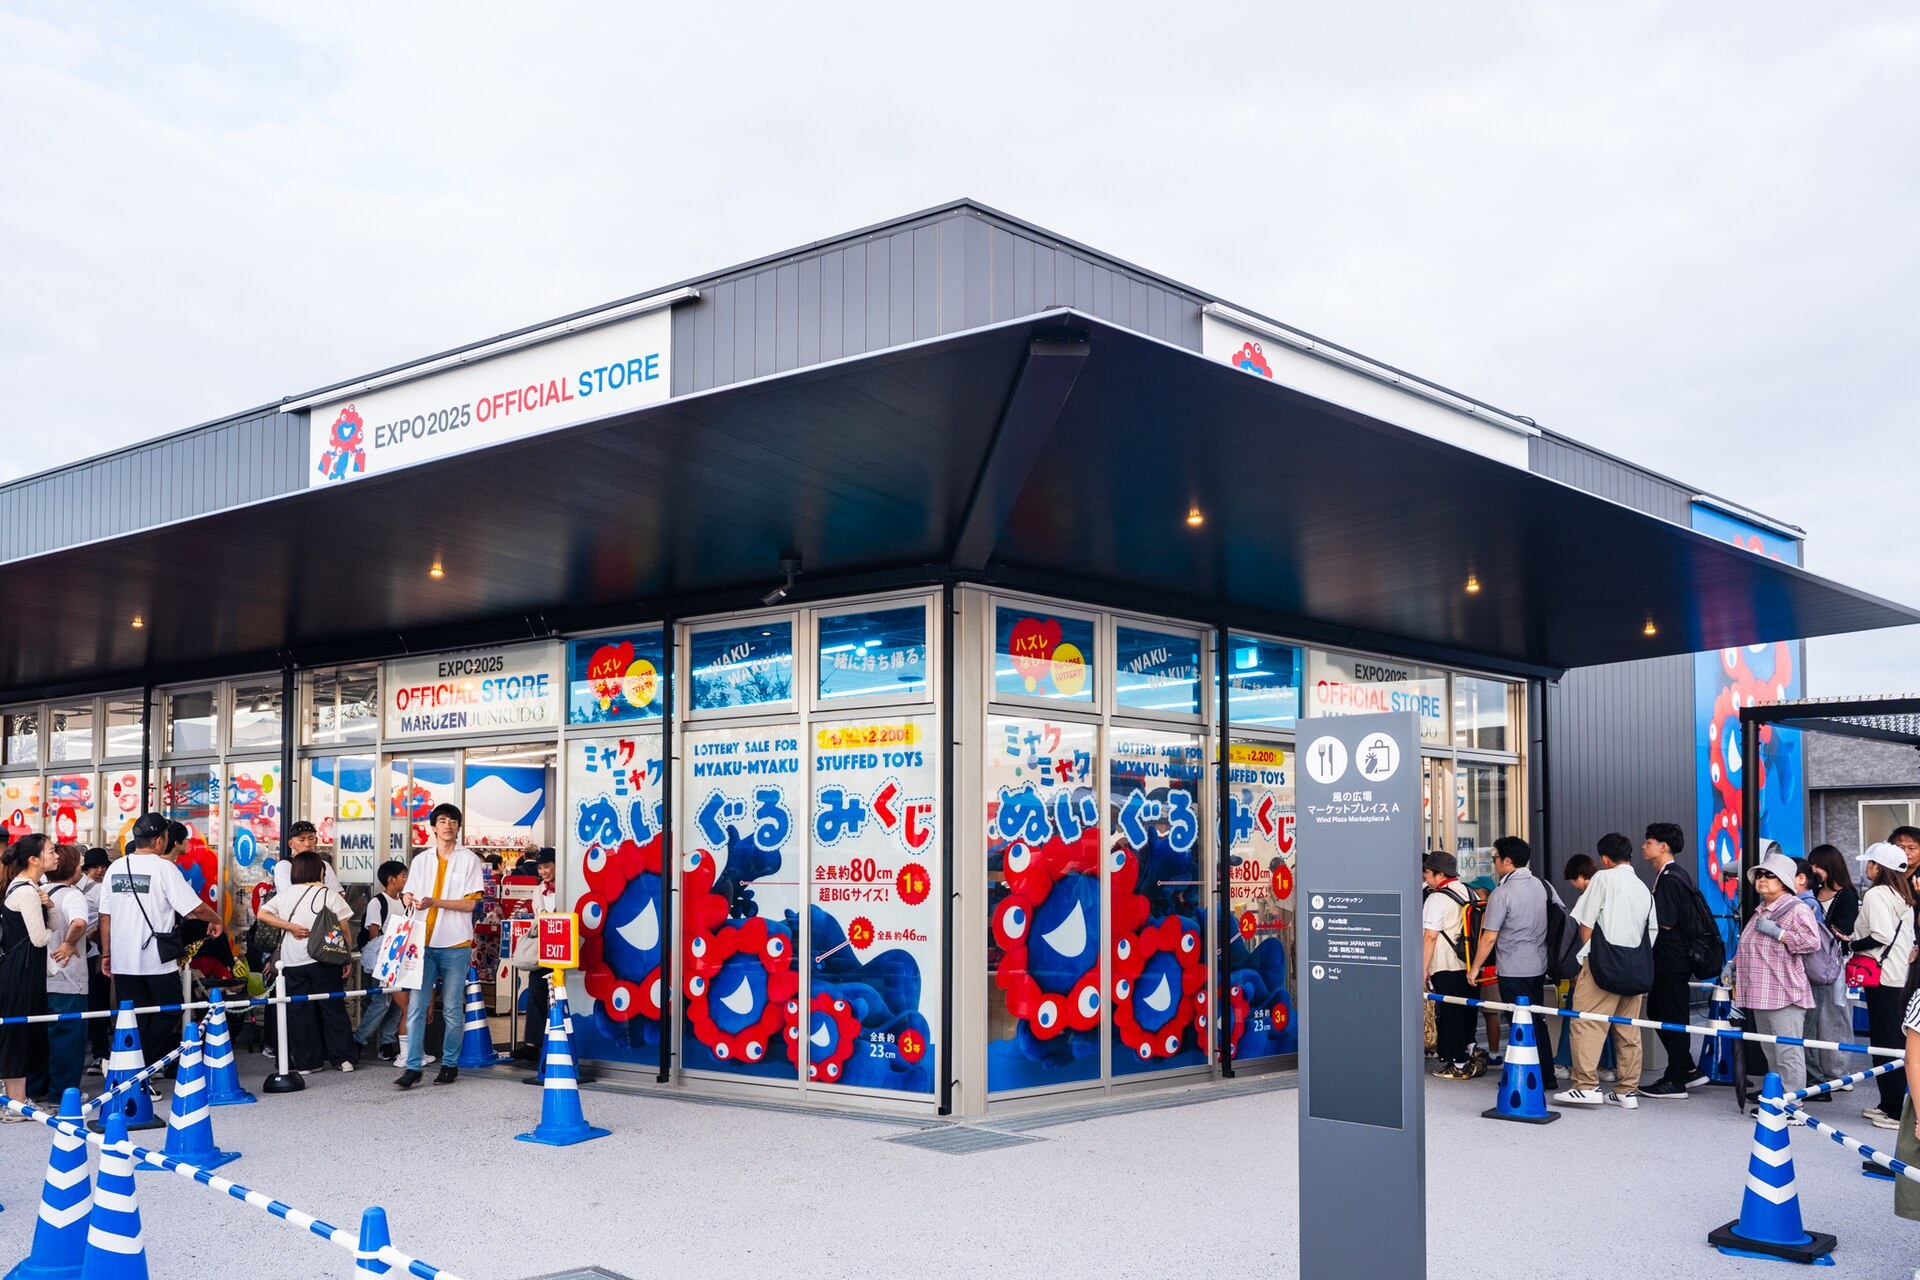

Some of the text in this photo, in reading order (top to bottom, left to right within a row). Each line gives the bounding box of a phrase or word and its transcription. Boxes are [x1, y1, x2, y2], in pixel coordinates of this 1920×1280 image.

[374, 352, 660, 449] EXPO2025 OFFICIAL STORE
[1016, 634, 1048, 653] ハズレ
[438, 655, 504, 678] EXPO2025
[592, 658, 622, 679] ハズレ
[1355, 663, 1407, 685] EXPO2025
[396, 673, 549, 711] OFFICIAL STORE
[1317, 680, 1440, 718] OFFICIAL STORE
[401, 705, 544, 733] MARUZEN JUNKUDO
[694, 738, 798, 756] LOTTERY SALE FOR
[1004, 723, 1061, 757] ミャク
[584, 739, 635, 773] ミャク
[1117, 741, 1203, 760] LOTTERY SALE FOR
[693, 758, 799, 778] MYAKU-MYAKU
[816, 751, 924, 772] STUFFED TOYS
[1037, 749, 1090, 787] ミャク
[1116, 760, 1204, 780] MYAKU-MYAKU
[612, 758, 663, 796] ミャク
[1260, 770, 1285, 785] TOYS
[1332, 790, 1373, 802] 風の広場
[698, 790, 789, 848] ぐる
[816, 782, 932, 849] みくじ
[998, 786, 1096, 842] ぬい
[1121, 791, 1196, 849] ぐる
[1307, 802, 1400, 815] マーケットプレイス A
[1348, 815, 1384, 823] Marketplace
[815, 857, 893, 883] 全長約80cm
[902, 872, 924, 894] 1等
[818, 887, 889, 902] 超BIGサイズ!
[547, 919, 563, 934] 出口
[877, 928, 928, 942] 全長約46cm
[546, 944, 565, 958] EXIT
[1254, 1019, 1271, 1032] 23cm
[869, 1031, 895, 1043] 全長約
[869, 1043, 896, 1059] 23cm
